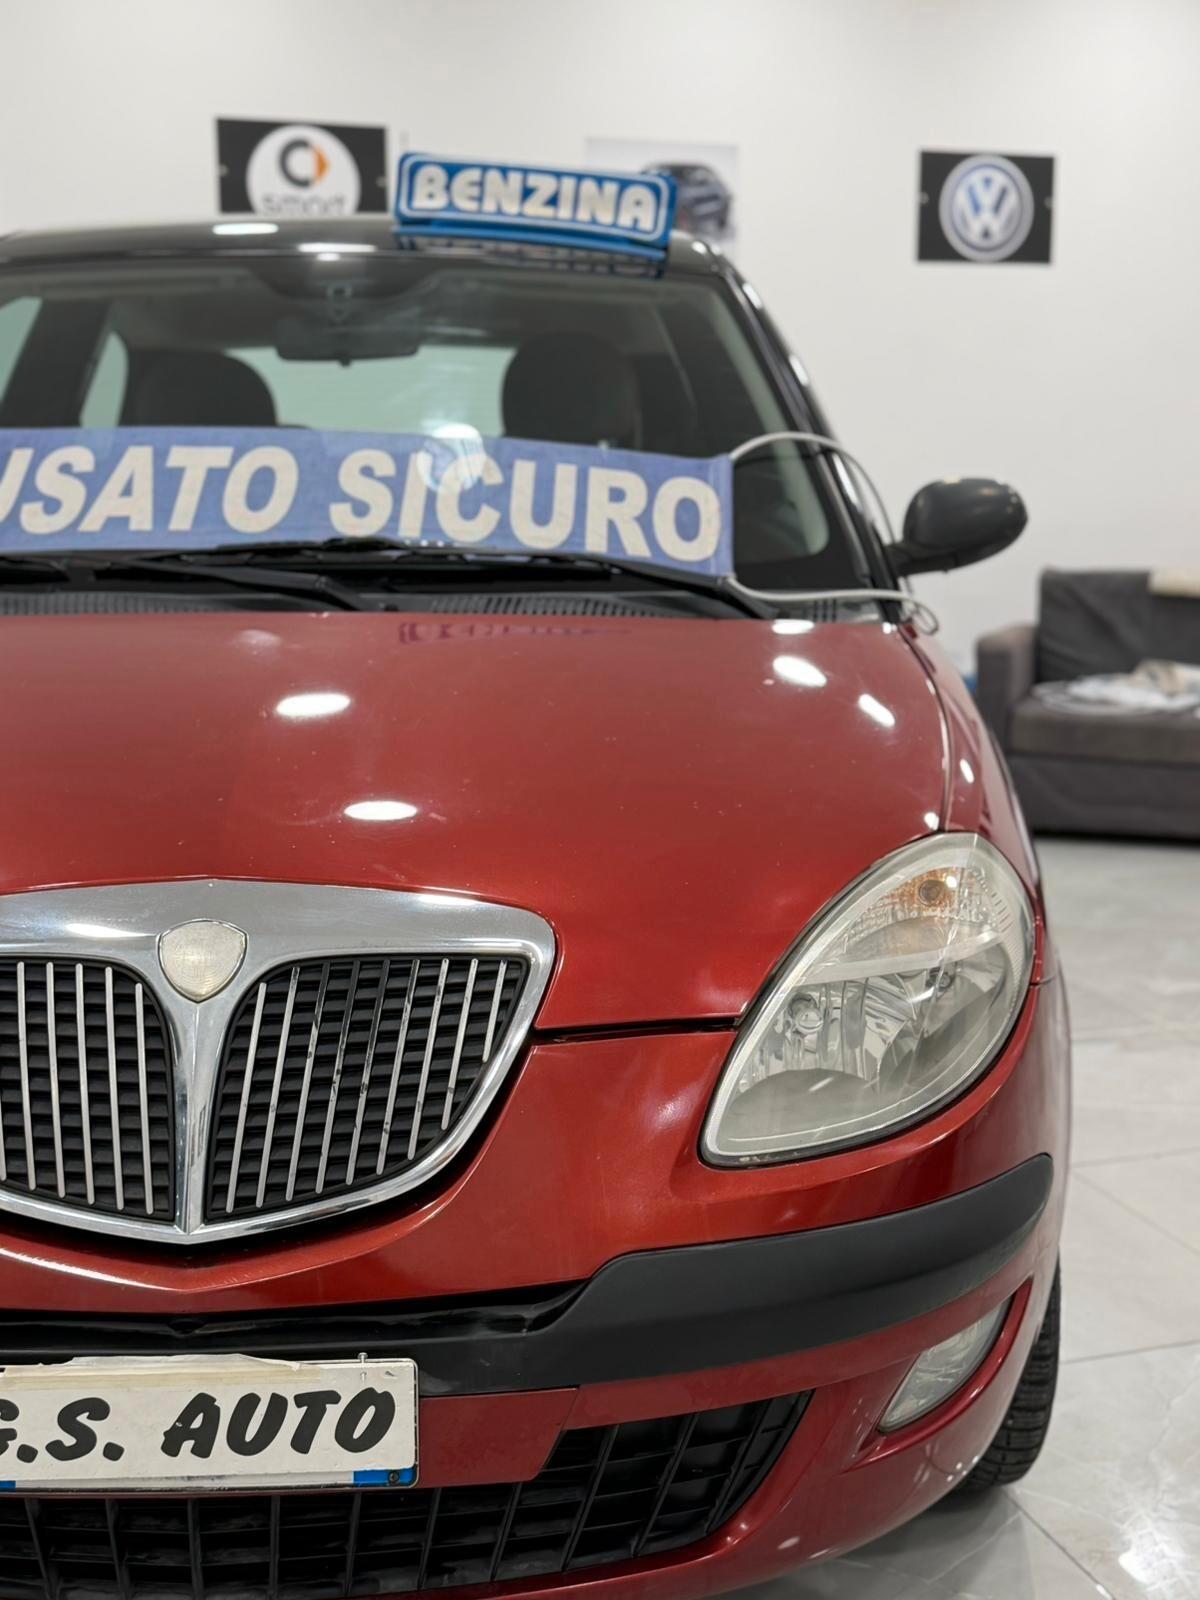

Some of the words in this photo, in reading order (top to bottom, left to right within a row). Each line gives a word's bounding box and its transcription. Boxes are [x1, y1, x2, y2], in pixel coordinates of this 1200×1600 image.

[411, 163, 657, 233] BENZINA
[329, 448, 721, 562] SICURO
[161, 1386, 396, 1459] AUTO
